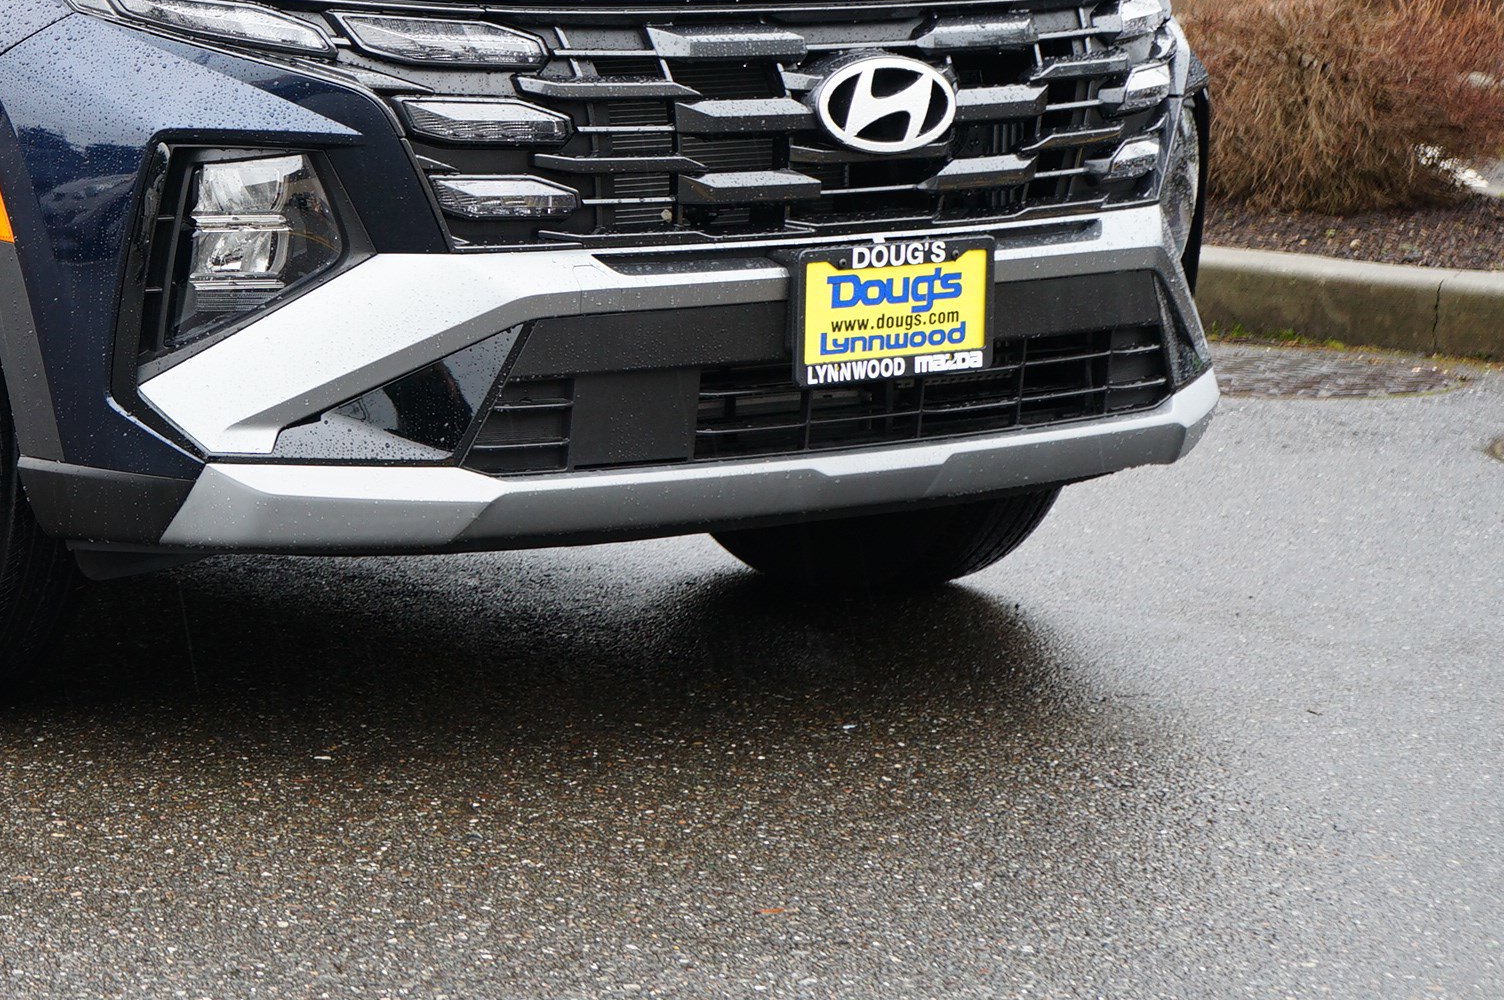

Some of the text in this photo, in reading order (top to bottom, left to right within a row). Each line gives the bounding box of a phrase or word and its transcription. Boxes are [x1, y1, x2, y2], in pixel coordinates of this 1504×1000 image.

[852, 241, 946, 269] DOUG'S
[826, 267, 962, 314] Doug's
[830, 310, 960, 333] www.dougs.com
[819, 321, 966, 356] Lynnwood
[806, 356, 906, 385] LYNNWOOD
